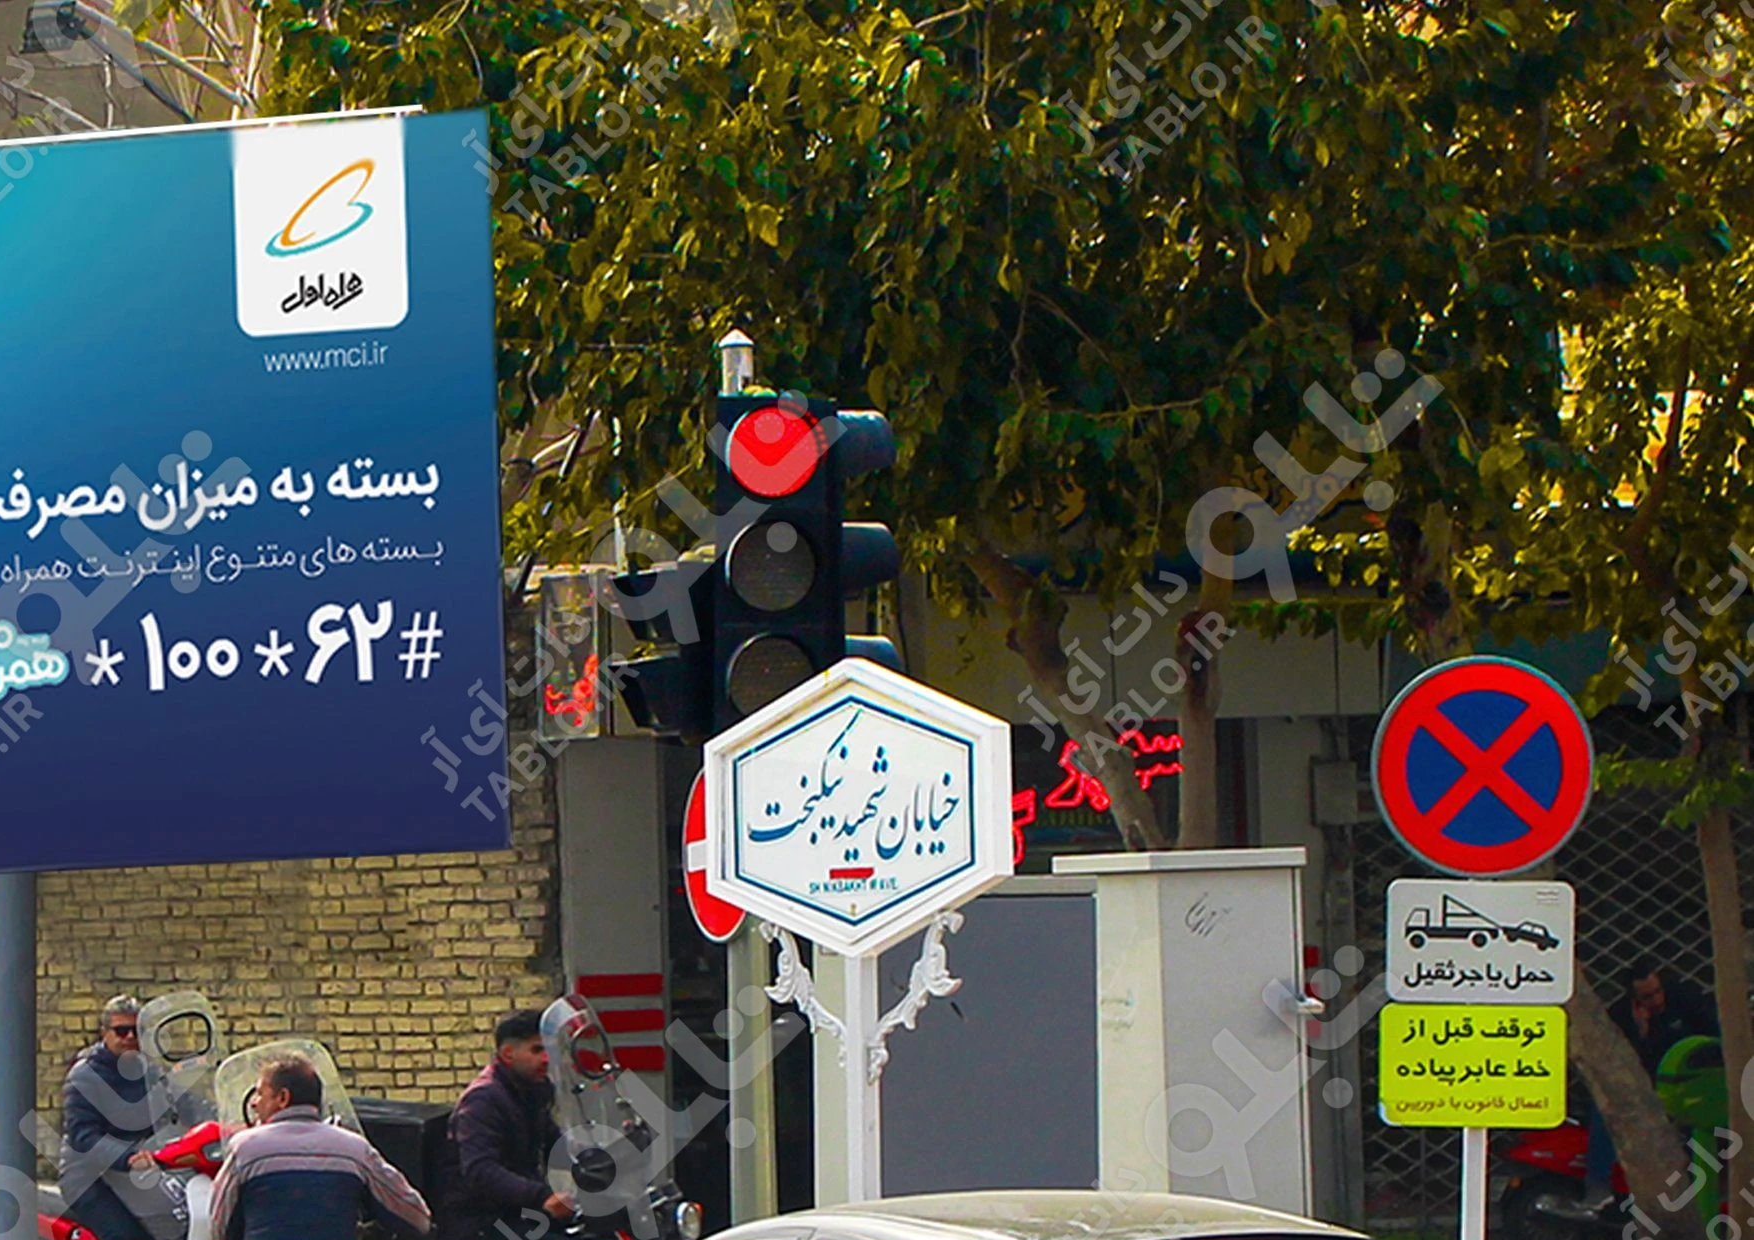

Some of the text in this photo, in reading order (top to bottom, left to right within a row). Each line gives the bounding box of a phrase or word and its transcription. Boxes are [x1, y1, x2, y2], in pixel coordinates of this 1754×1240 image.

[264, 340, 389, 373] www.mci.ir
[137, 460, 258, 531] میزان
[269, 465, 315, 518] به
[326, 456, 441, 510] بسته
[76, 543, 202, 589] اینترنت
[204, 541, 296, 583] متنوع
[300, 535, 358, 577] های
[362, 535, 445, 566] بسته
[0, 553, 72, 595] همراه
[747, 708, 863, 846] نیکبخت
[833, 745, 889, 862] شهید
[875, 772, 960, 861] خیابان
[1404, 960, 1485, 989] جرثقیل
[1504, 964, 1555, 990] حمل
[1402, 1017, 1546, 1047] توقف قبل از
[1396, 1057, 1550, 1086] خط عابر پیاده
